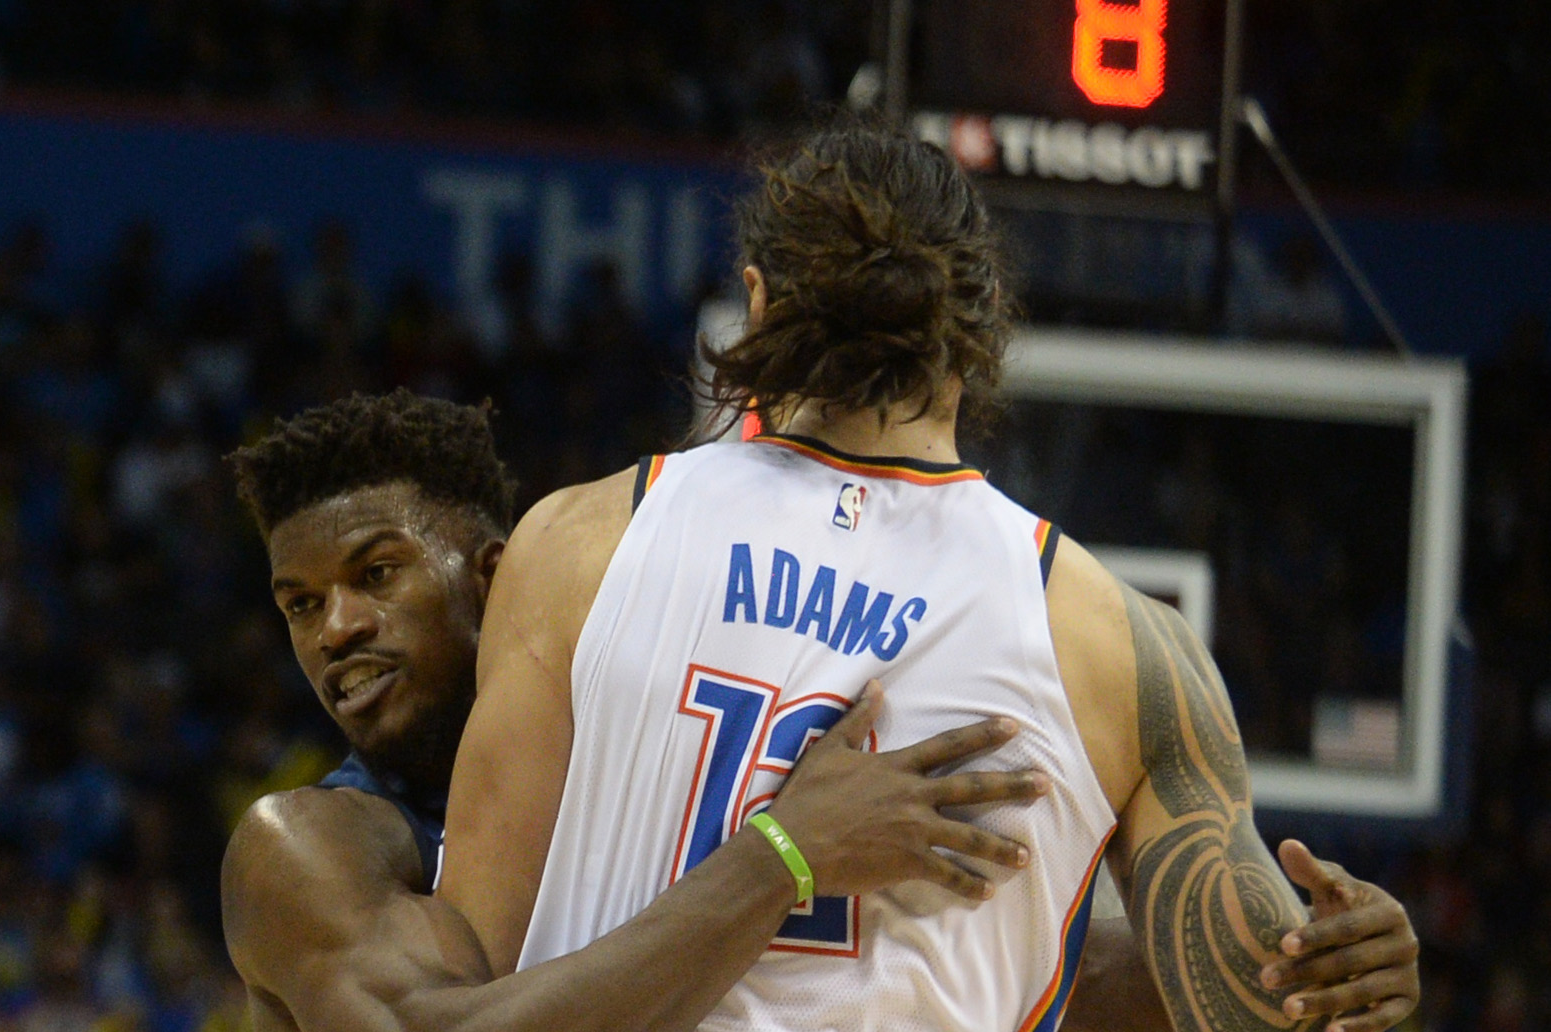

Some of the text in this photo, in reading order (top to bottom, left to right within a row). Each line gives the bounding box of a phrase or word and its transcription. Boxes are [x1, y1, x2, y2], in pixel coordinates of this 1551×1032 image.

[1072, 0, 1168, 108] 8
[991, 113, 1213, 190] TISSOT
[722, 543, 927, 662] ADAMS
